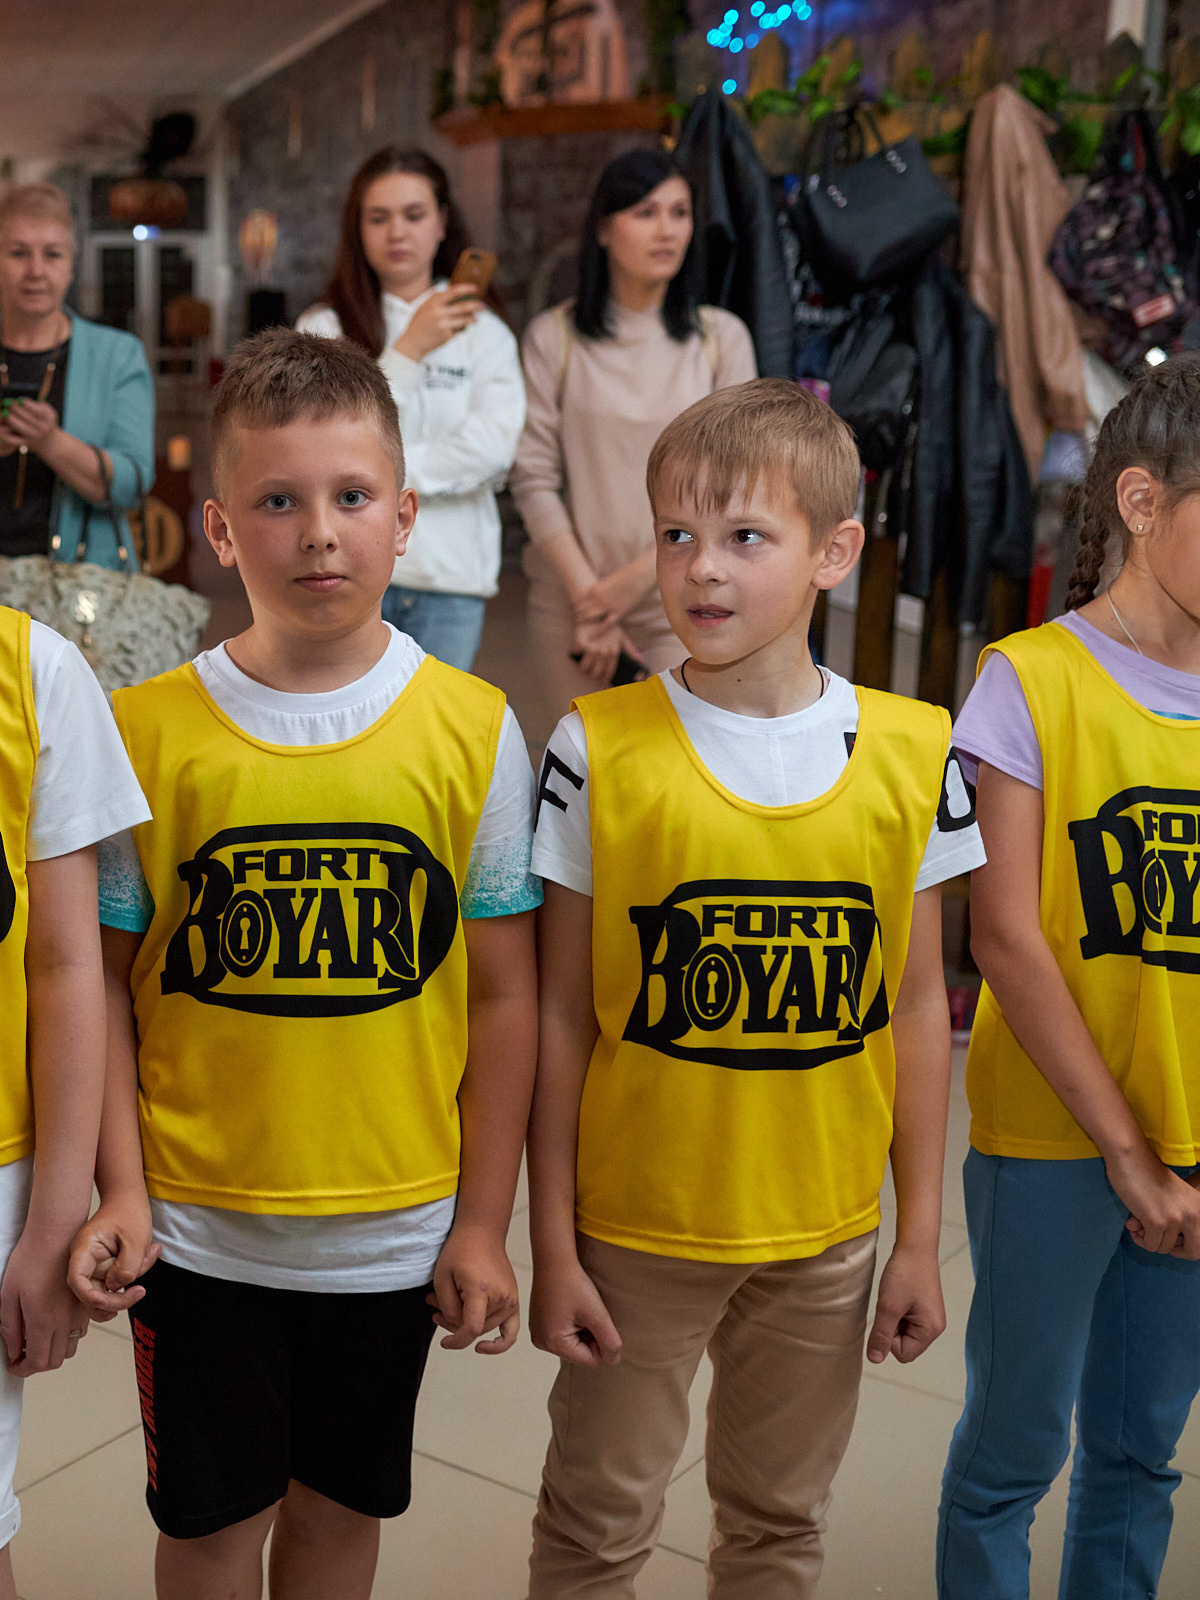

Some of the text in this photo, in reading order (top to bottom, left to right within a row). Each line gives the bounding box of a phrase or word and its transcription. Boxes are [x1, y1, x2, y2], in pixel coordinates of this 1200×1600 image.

[1141, 809, 1200, 846] FO
[232, 847, 380, 885] FORT
[160, 850, 458, 996] BOYARD
[701, 903, 844, 939] FORT
[621, 905, 890, 1042] BOYARD
